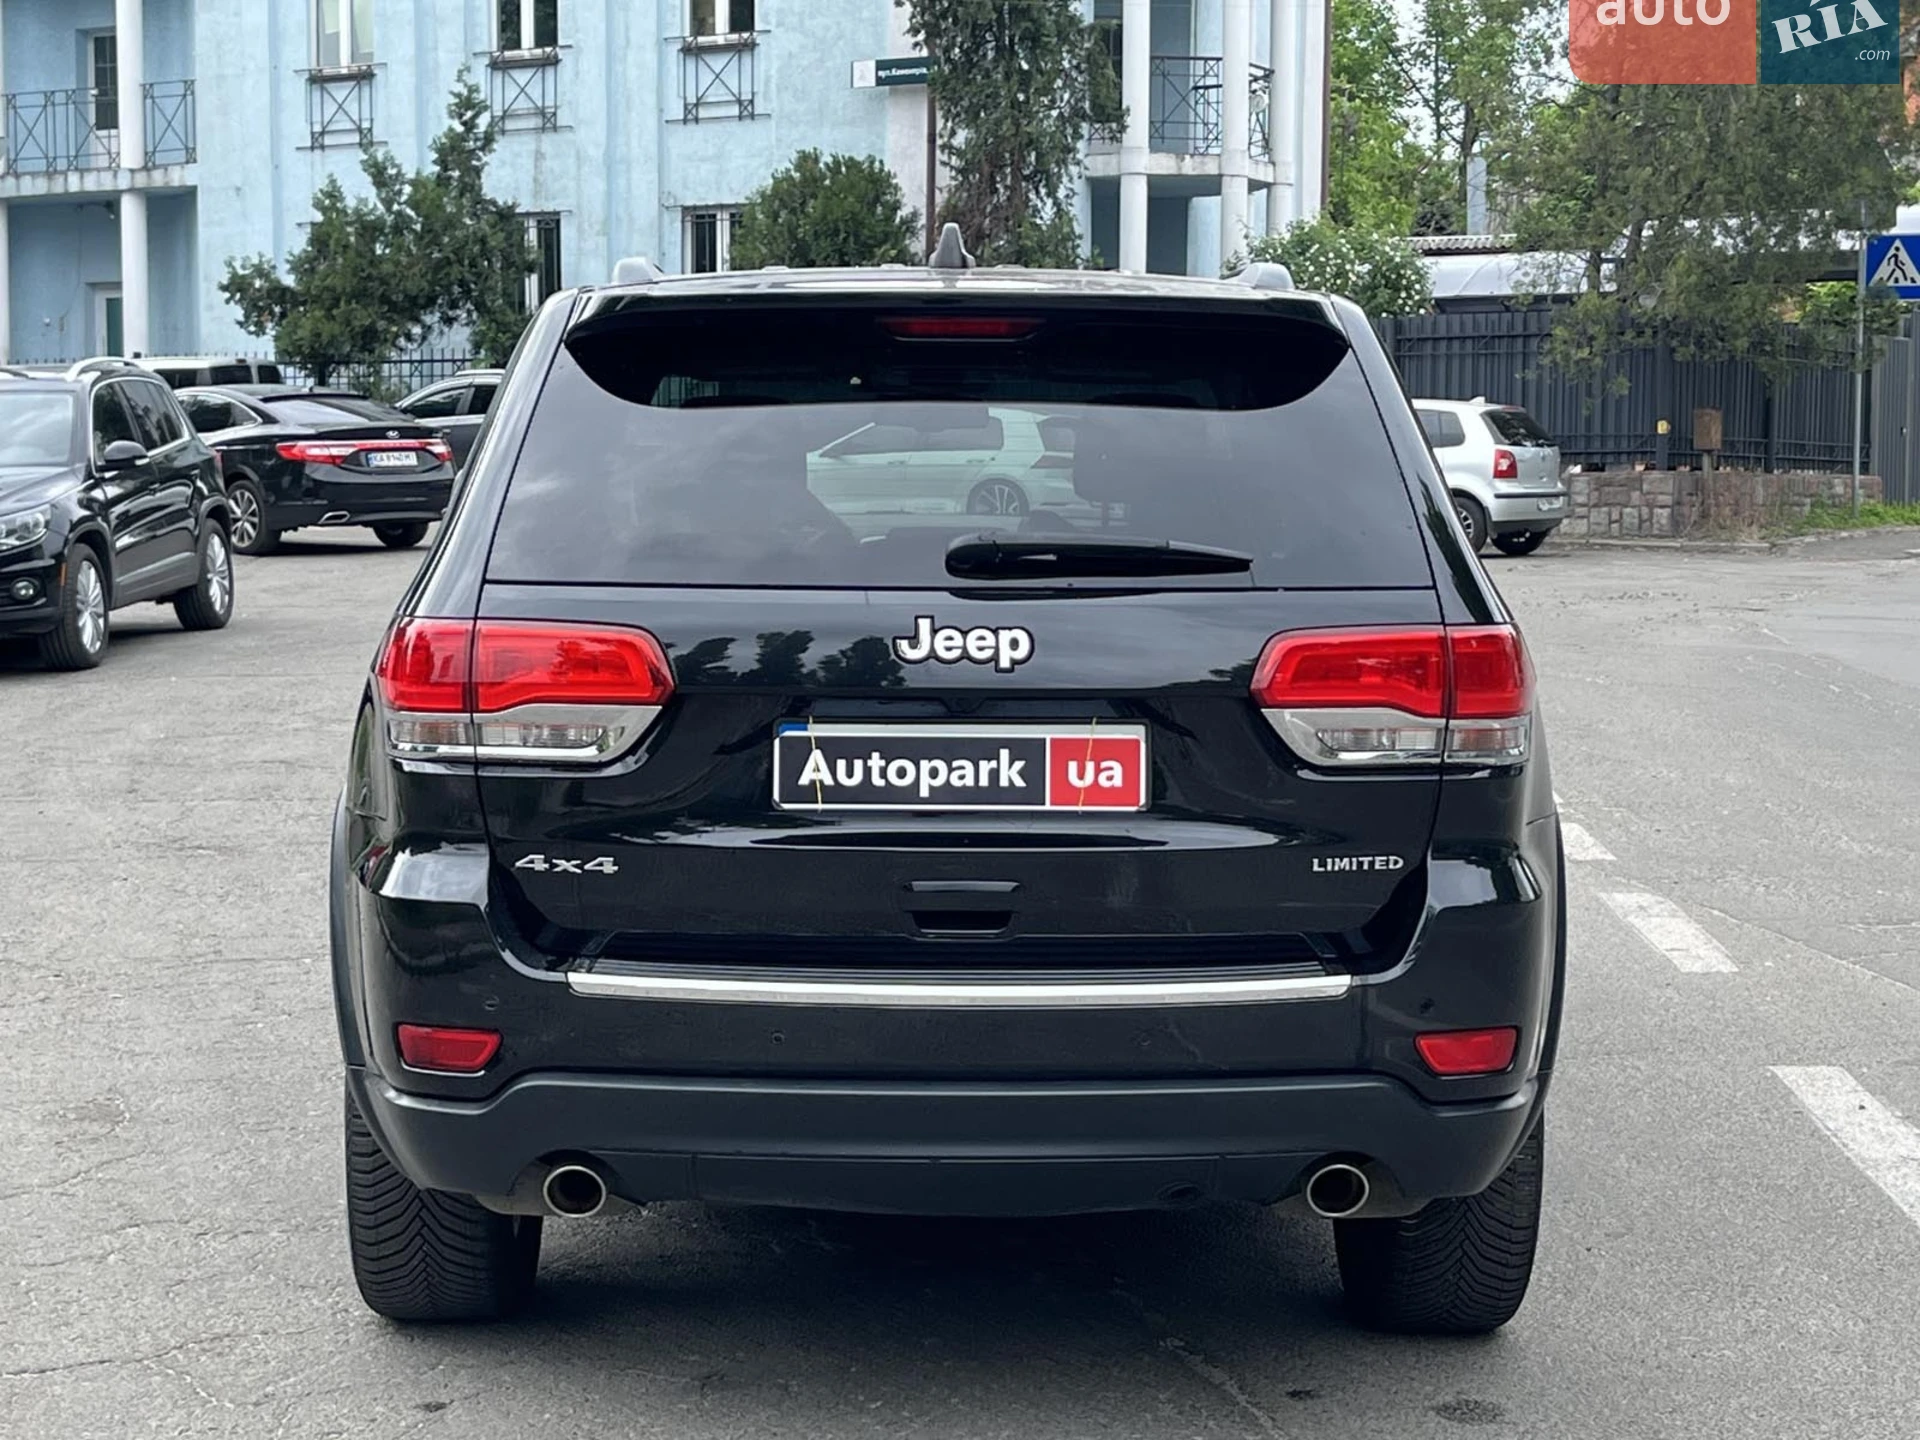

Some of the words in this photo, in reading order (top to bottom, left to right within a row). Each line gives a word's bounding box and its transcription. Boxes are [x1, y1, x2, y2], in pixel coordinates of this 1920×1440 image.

[893, 616, 1034, 672] Jeep
[797, 748, 1027, 798] Autopark
[1066, 759, 1124, 788] ua
[514, 854, 619, 874] 4x4
[1312, 855, 1404, 872] LIMITED
